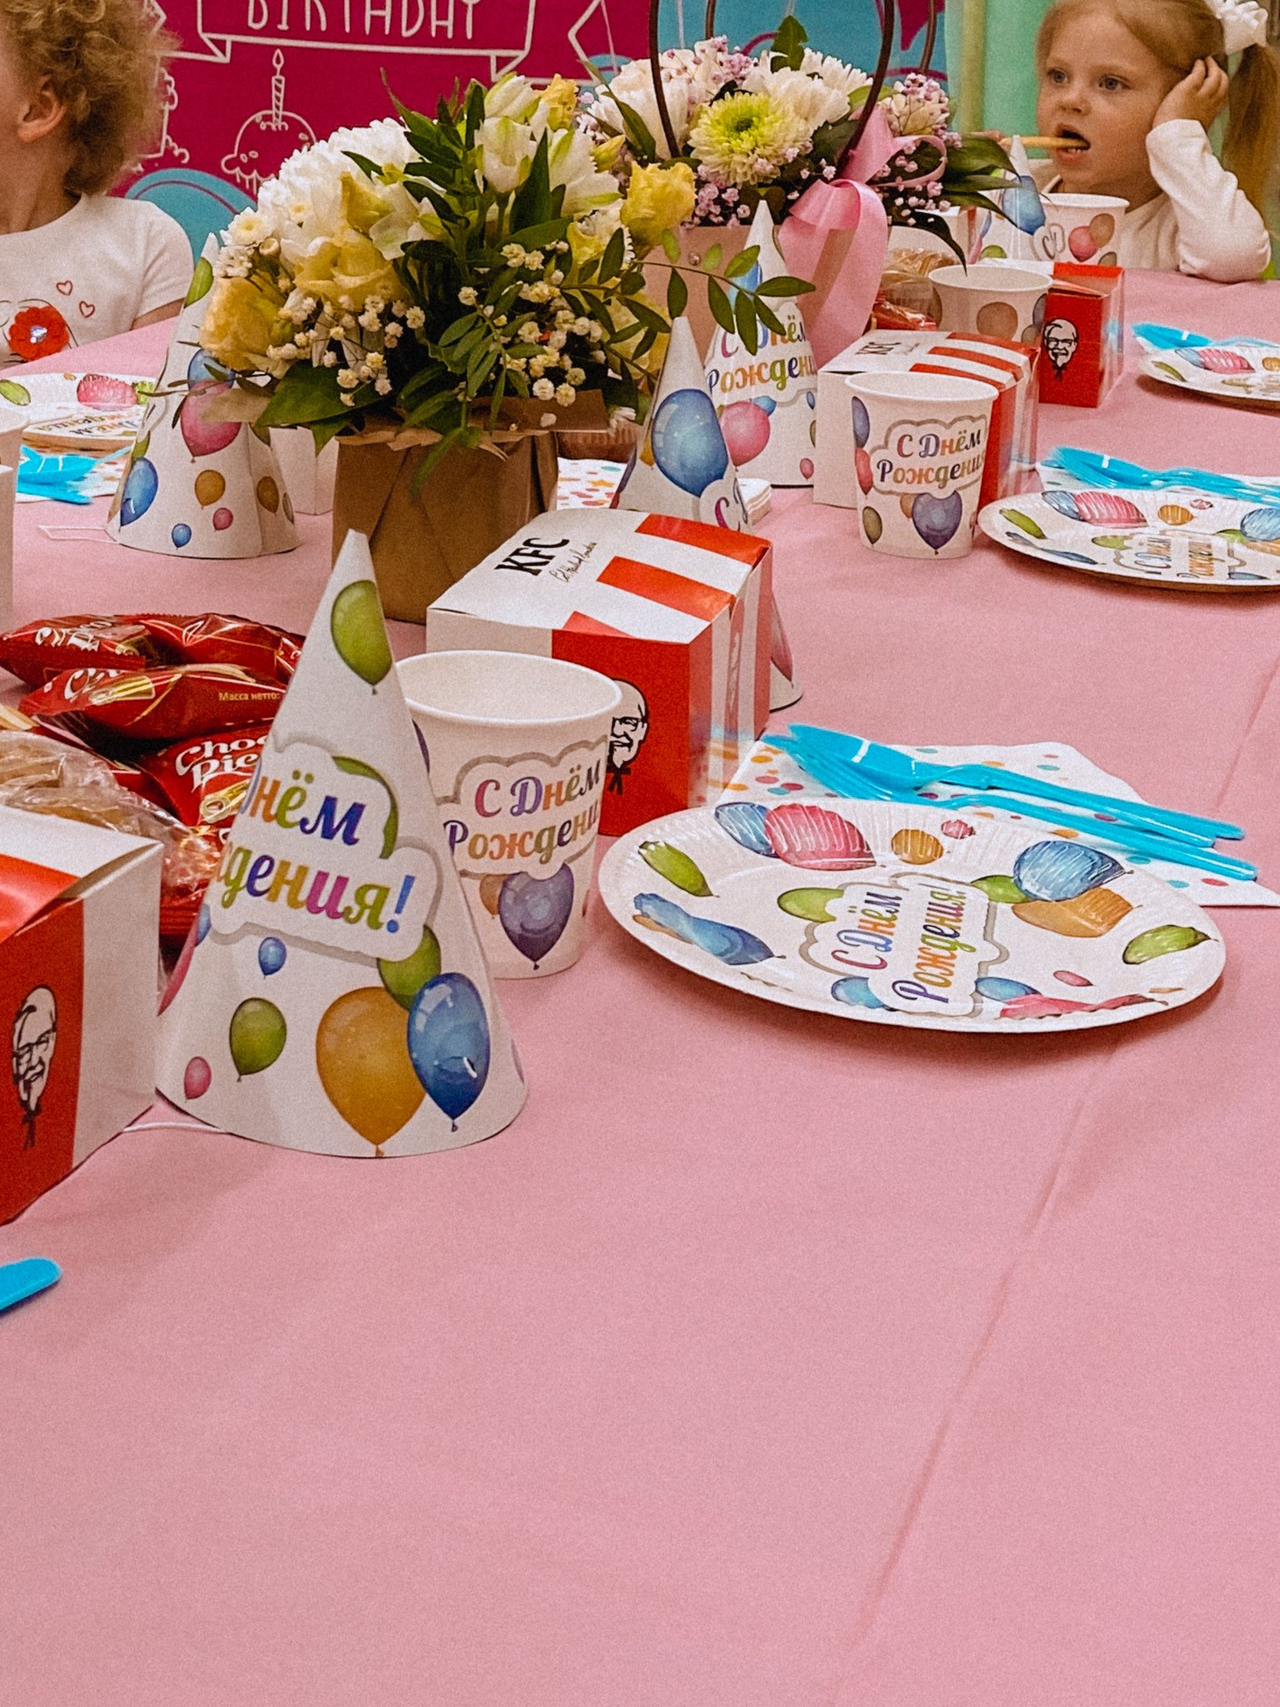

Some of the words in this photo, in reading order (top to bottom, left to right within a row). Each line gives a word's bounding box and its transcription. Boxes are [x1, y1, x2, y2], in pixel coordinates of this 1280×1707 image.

[897, 434, 914, 458] С
[919, 429, 981, 458] Днём
[494, 538, 570, 576] KFC
[240, 759, 366, 846] нём
[475, 779, 502, 817] С
[510, 759, 600, 816] Днём
[443, 799, 599, 865] Рождени
[217, 844, 416, 934] дения!
[837, 891, 902, 952] Днём
